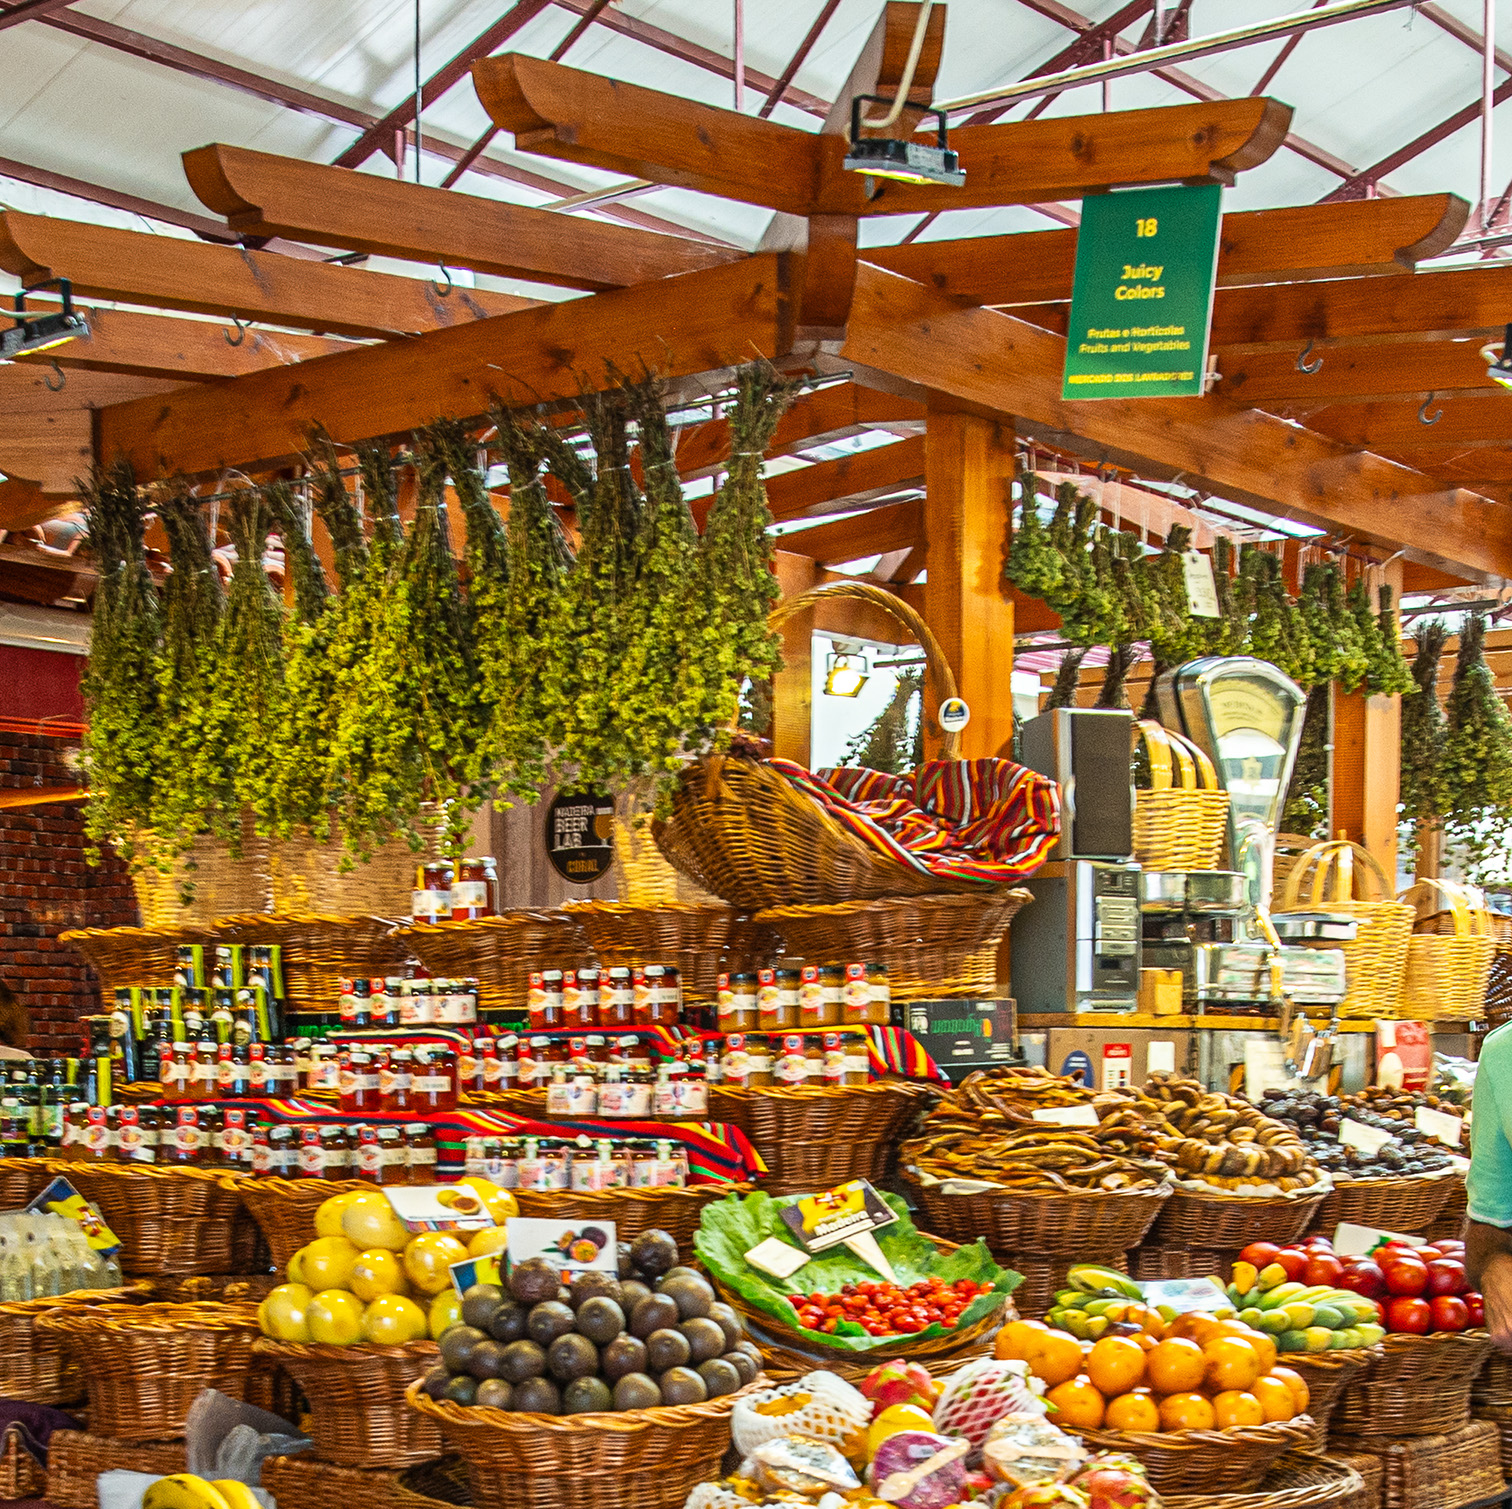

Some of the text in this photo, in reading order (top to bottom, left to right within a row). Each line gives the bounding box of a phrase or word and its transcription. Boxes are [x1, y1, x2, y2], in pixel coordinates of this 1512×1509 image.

[1136, 218, 1158, 238] 18
[1121, 263, 1164, 282] Juicy
[1114, 284, 1165, 300] Colors
[1087, 327, 1121, 339] Frutas
[1122, 329, 1129, 338] e
[1079, 340, 1190, 354] Fruits and Vegetables
[1068, 374, 1114, 384] MERCADO
[1114, 373, 1134, 383] DOS
[554, 817, 588, 833] BEER
